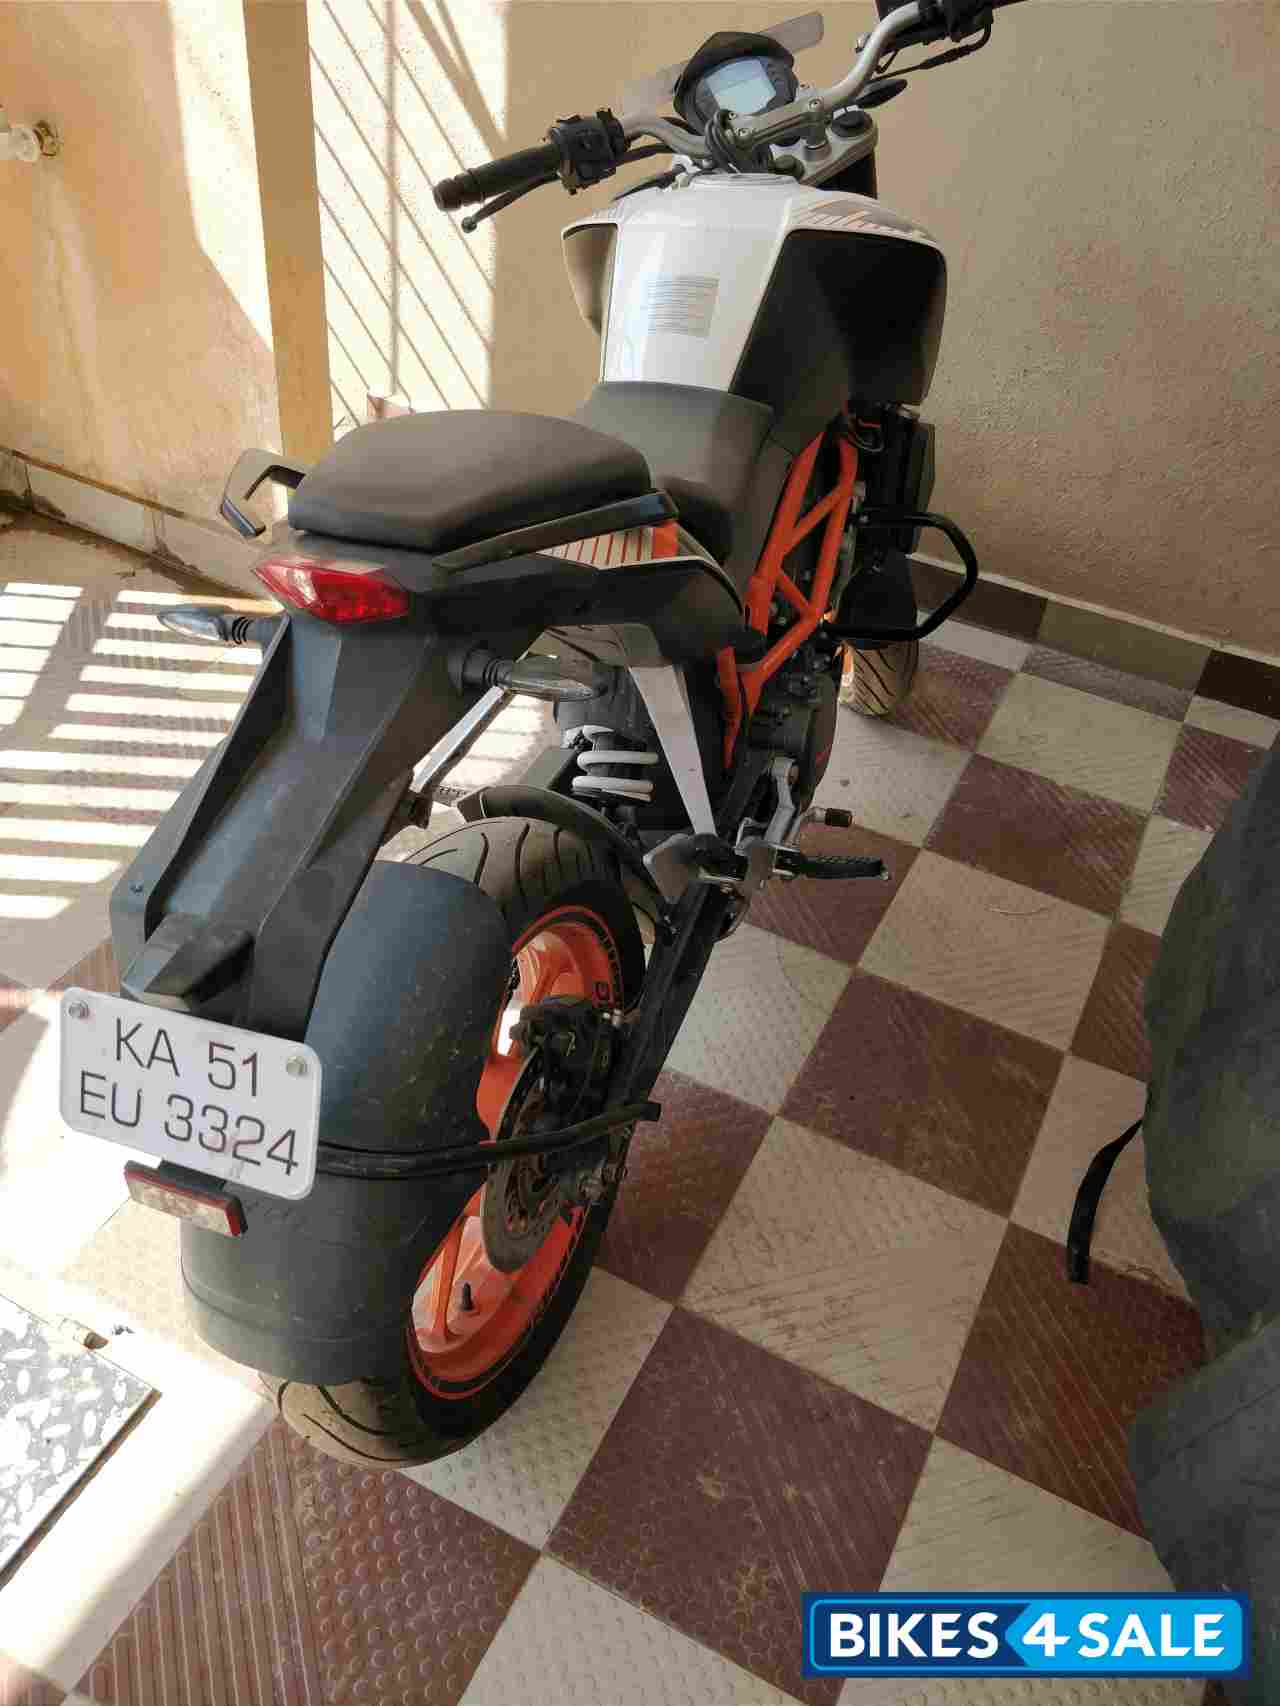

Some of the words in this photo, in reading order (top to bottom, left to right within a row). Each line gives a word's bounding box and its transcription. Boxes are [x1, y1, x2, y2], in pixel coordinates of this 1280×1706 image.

[114, 1017, 180, 1077] KA
[207, 1040, 258, 1097] 51
[80, 1070, 143, 1128] EU
[163, 1093, 299, 1177] 3324
